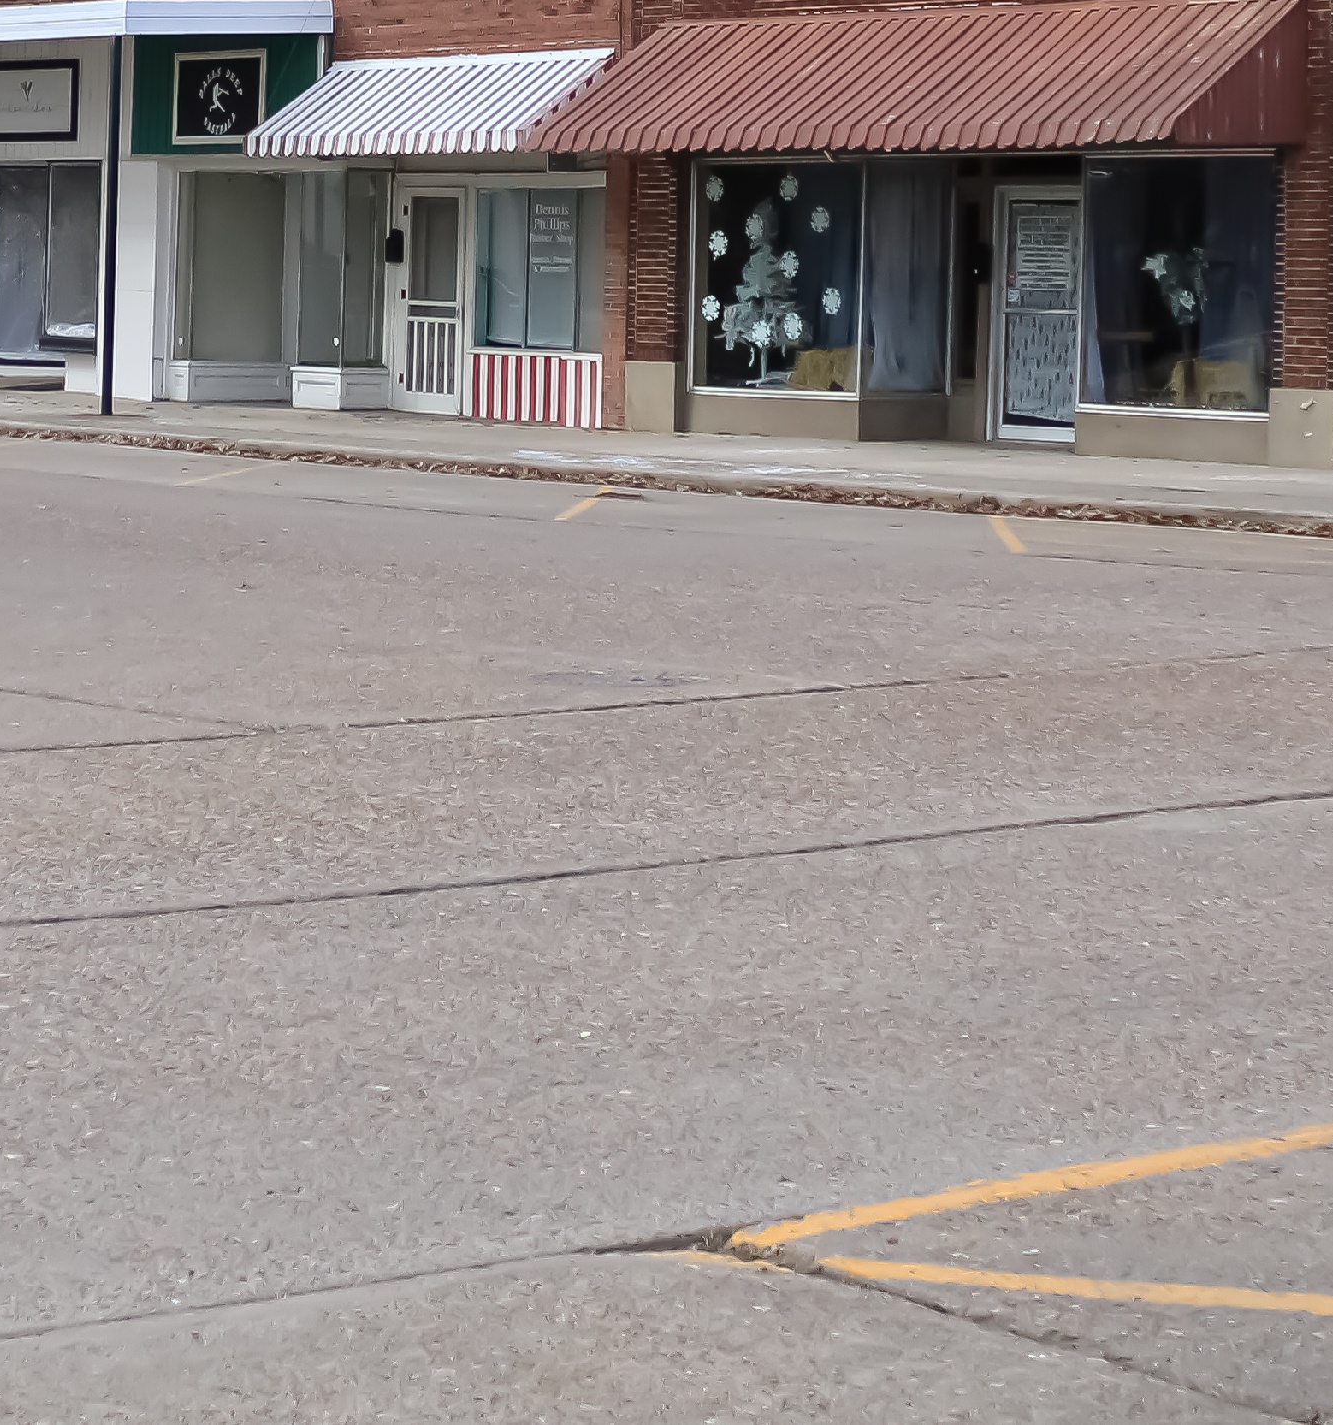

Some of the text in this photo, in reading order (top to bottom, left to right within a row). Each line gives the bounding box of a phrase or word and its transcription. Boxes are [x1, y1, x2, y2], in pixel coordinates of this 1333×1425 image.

[226, 69, 243, 96] DEEP
[535, 203, 570, 215] Dennis
[534, 218, 571, 233] Phillips
